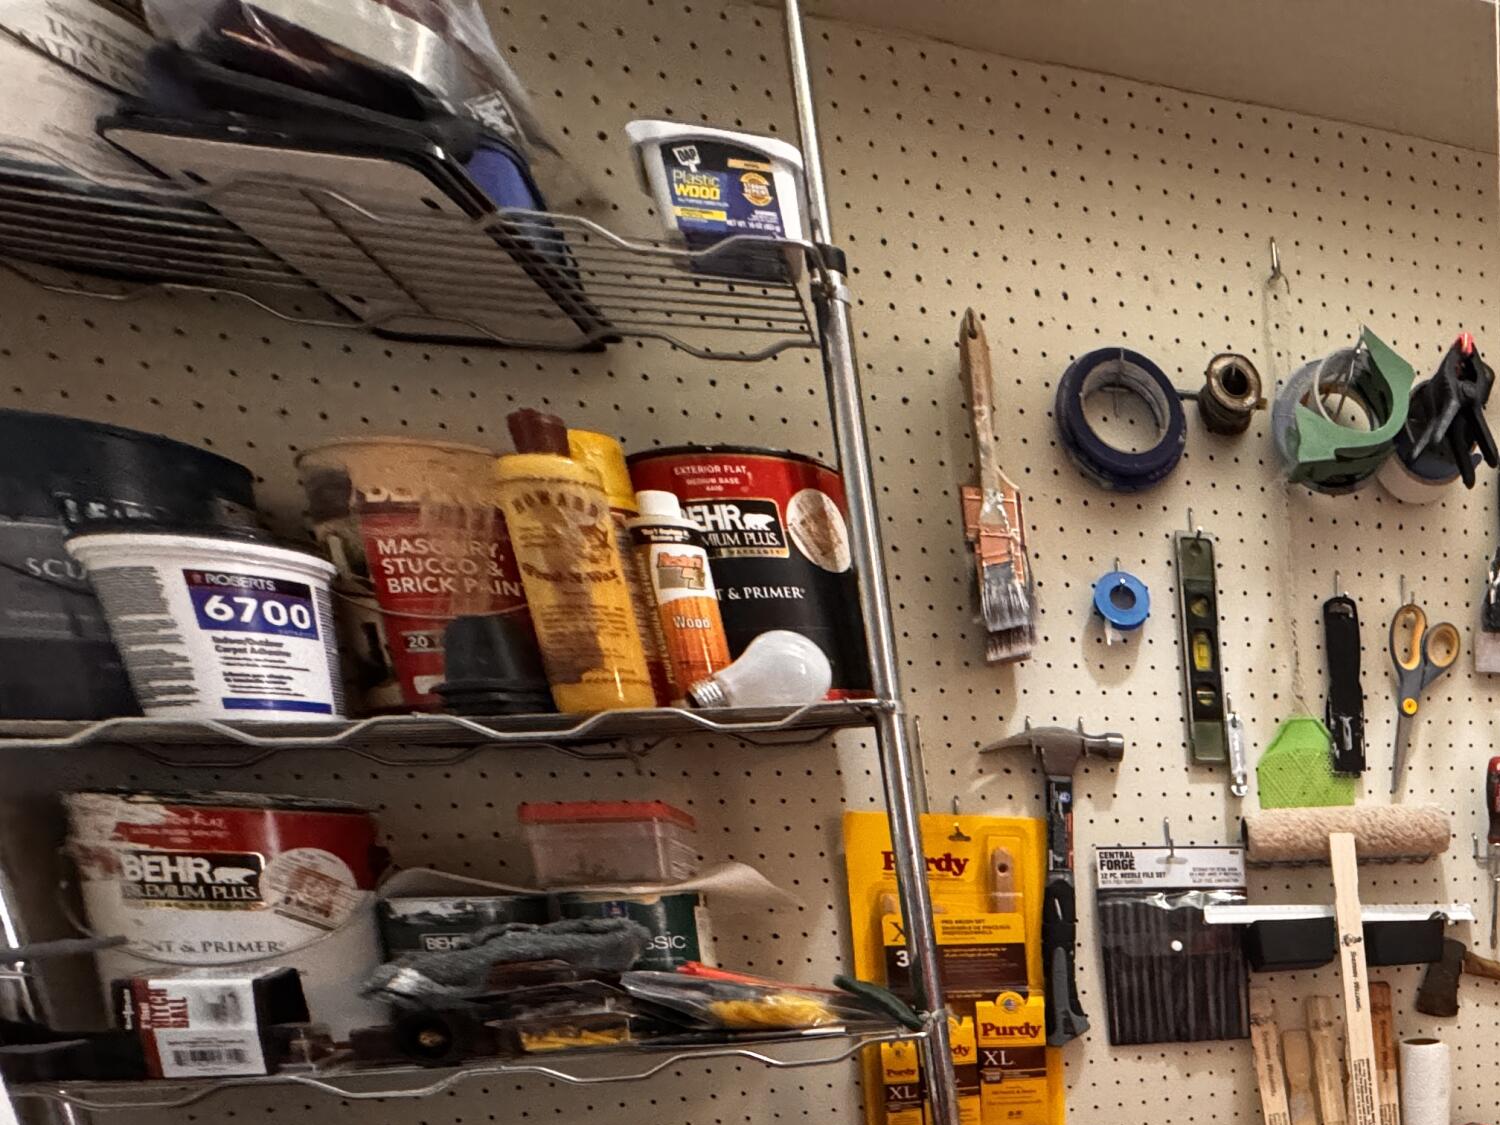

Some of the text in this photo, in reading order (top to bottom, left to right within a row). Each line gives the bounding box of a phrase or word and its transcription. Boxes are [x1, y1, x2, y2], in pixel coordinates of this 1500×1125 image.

[676, 148, 698, 163] DAP
[672, 169, 721, 187] Plastic
[674, 184, 721, 200] WOOD
[673, 465, 746, 475] EXTERIOR FLAT
[718, 477, 740, 485] BASE
[381, 557, 504, 578] STUCCO &
[205, 572, 277, 592] ROBERTS
[387, 577, 525, 598] BRICK PAIN
[728, 587, 741, 600] &
[204, 595, 312, 630] 6700
[407, 636, 429, 649] 20
[881, 850, 970, 877] Prdy
[1099, 851, 1136, 860] CENTRAL
[120, 854, 212, 886] BEHR
[1099, 858, 1137, 872] FORGE
[121, 883, 205, 900] PREMIUM
[178, 941, 196, 954] &
[424, 936, 462, 952] BEH
[149, 988, 170, 1029] HITCH
[167, 997, 190, 1030] BALL
[981, 1021, 1042, 1039] Purdy
[983, 1050, 1014, 1067] XL
[886, 1068, 917, 1078] Purdy
[888, 1085, 917, 1100] XL
